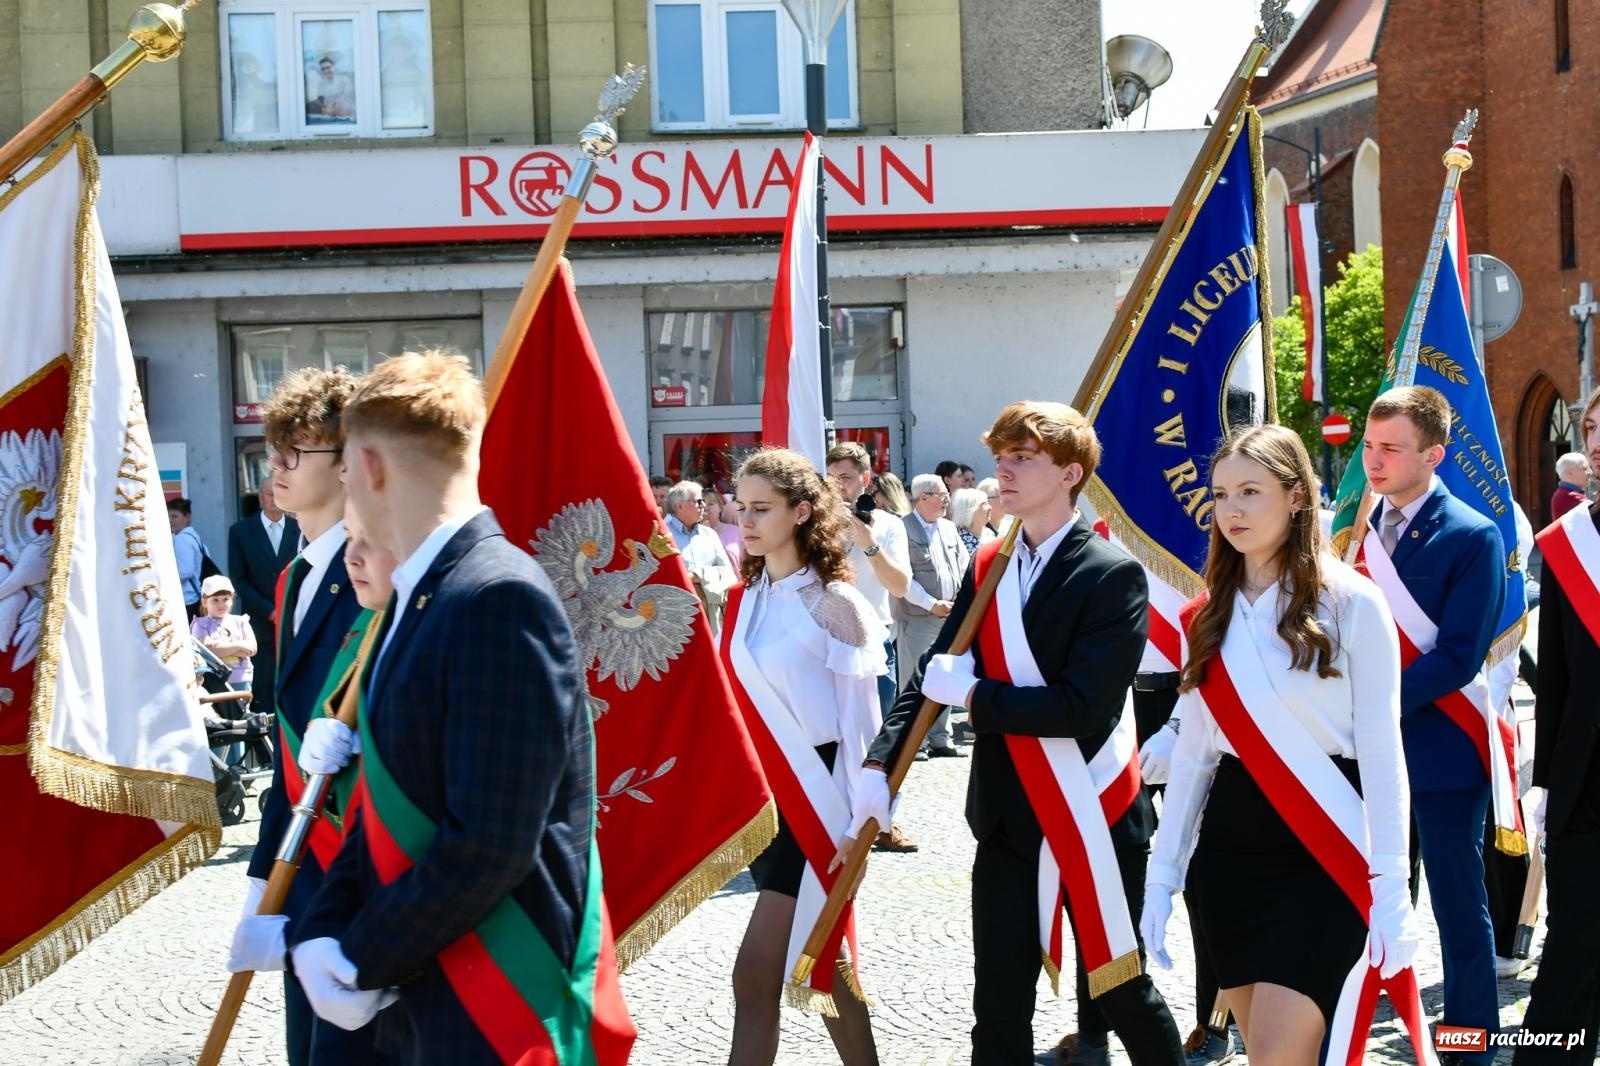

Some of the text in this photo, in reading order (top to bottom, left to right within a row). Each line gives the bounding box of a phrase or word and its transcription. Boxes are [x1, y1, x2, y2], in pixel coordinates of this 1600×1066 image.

[459, 144, 935, 217] ROSSMANN
[1157, 355, 1189, 376] I
[1153, 412, 1187, 449] W
[1454, 450, 1508, 518] KULTURE
